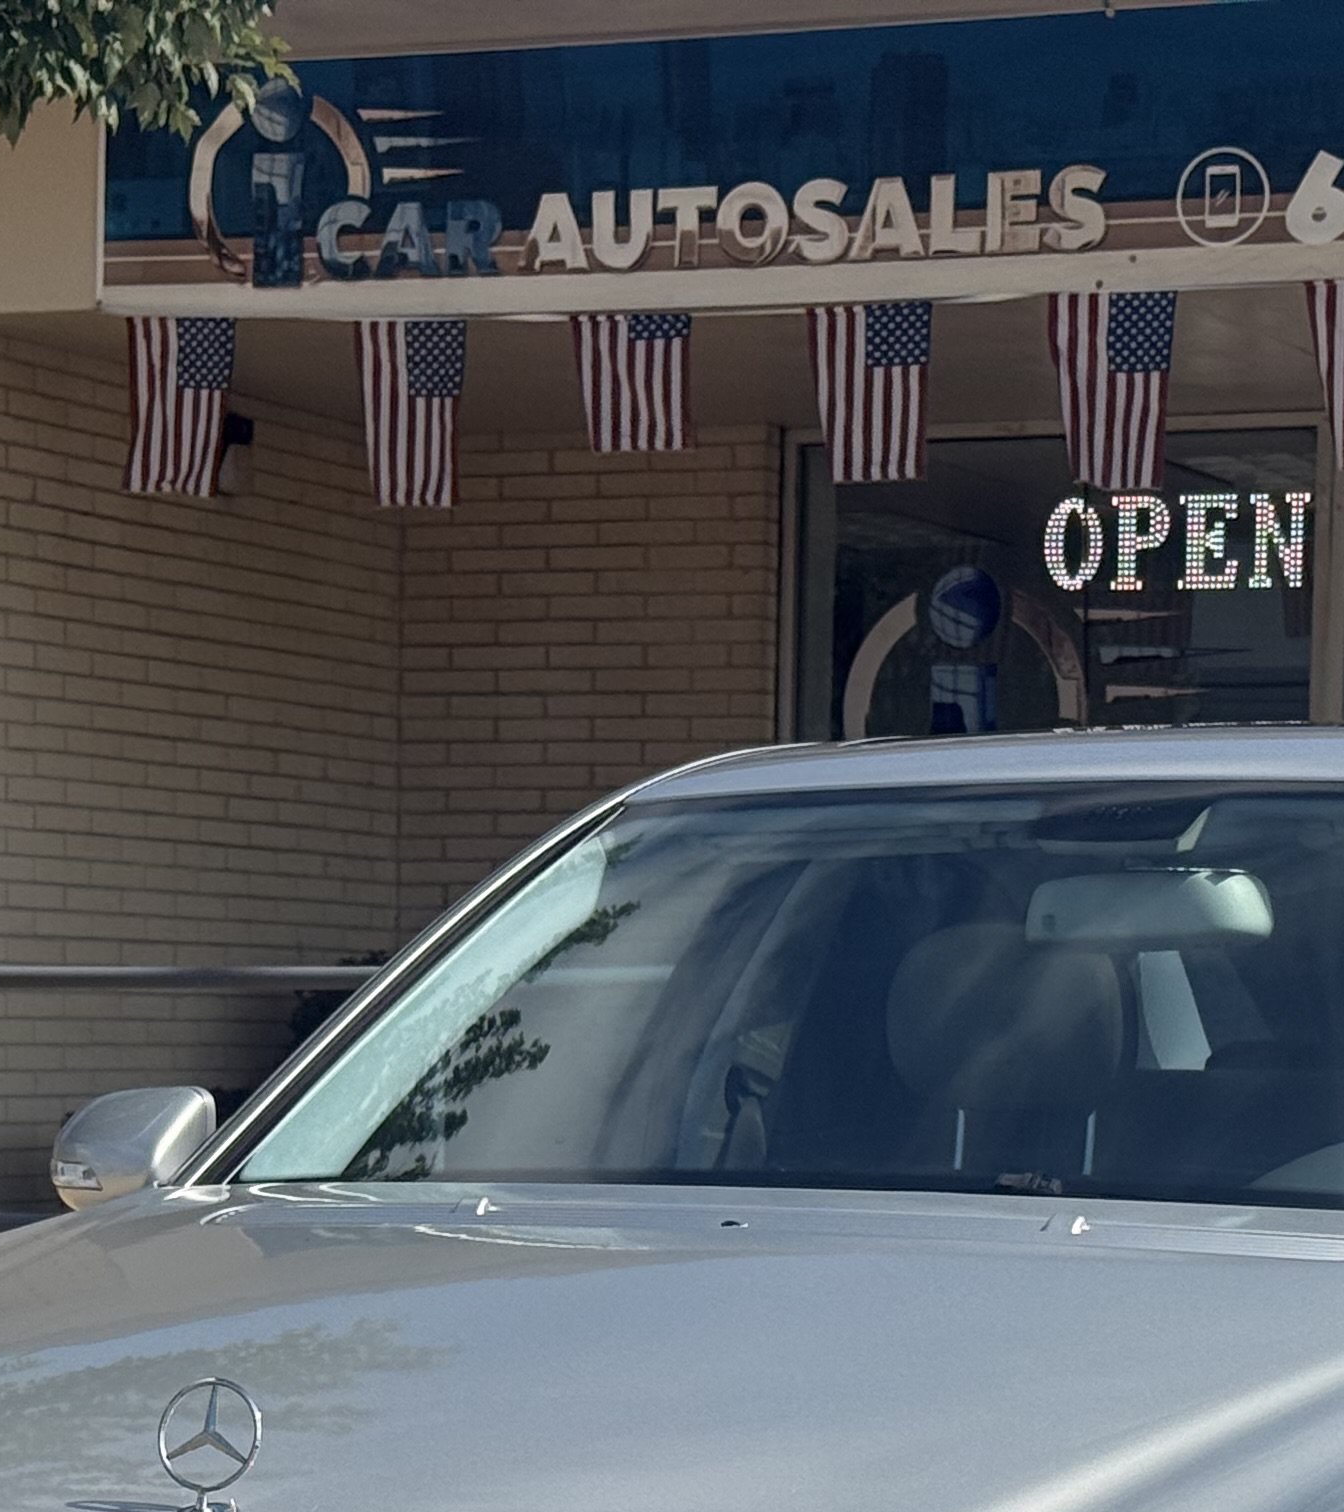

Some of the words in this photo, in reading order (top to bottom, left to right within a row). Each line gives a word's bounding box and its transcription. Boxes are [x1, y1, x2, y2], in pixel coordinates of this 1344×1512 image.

[316, 200, 503, 281] CAR
[519, 165, 1108, 274] AUTOSALES
[1042, 490, 1312, 593] OPEN
